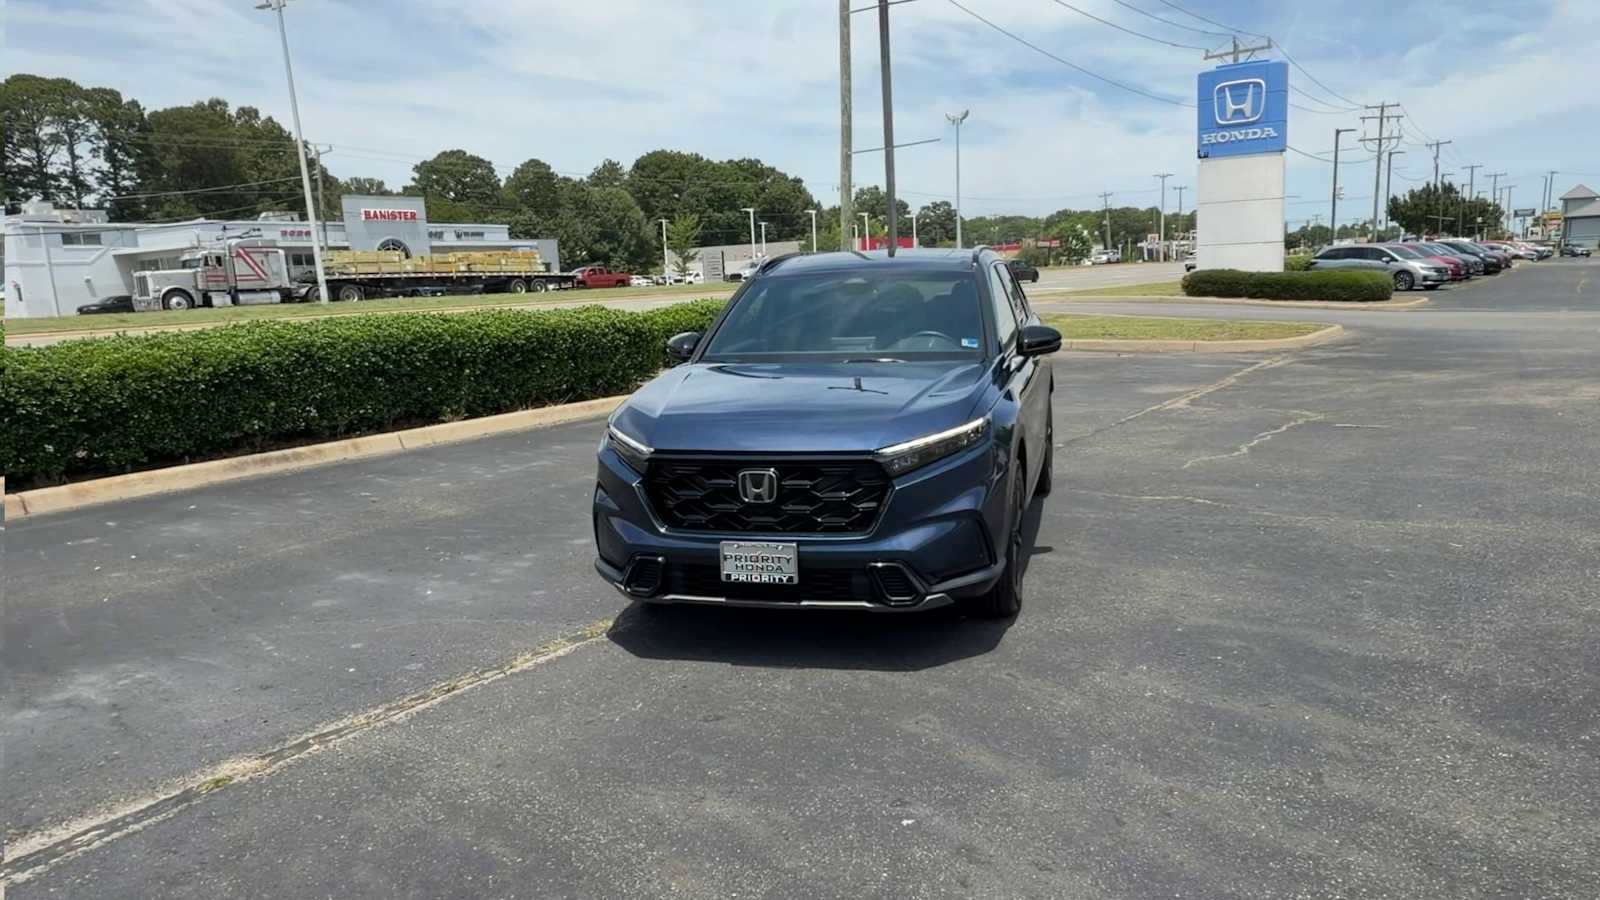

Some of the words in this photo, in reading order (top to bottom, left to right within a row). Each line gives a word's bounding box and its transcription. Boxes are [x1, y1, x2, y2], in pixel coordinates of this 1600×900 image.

[1201, 127, 1278, 144] HONDA
[364, 209, 417, 221] BANISTER
[723, 553, 793, 564] PRIORITY
[735, 564, 784, 573] HONDA
[731, 574, 789, 584] PRIORITY
